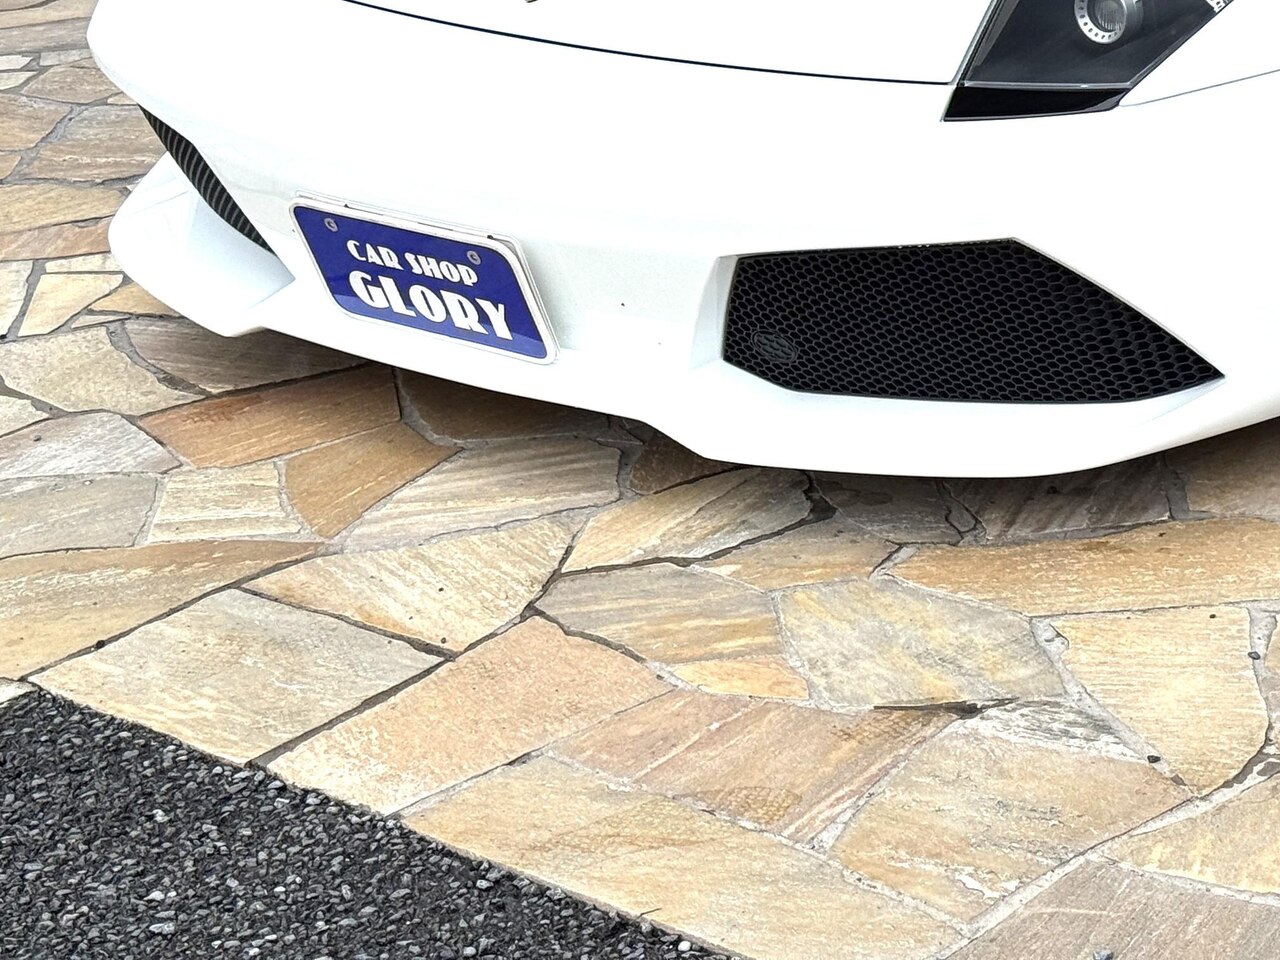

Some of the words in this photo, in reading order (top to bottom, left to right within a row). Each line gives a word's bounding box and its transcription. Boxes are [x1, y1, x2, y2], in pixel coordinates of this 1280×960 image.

[346, 240, 403, 270] CAR
[405, 252, 479, 287] SHOP
[349, 270, 514, 340] GLORY
